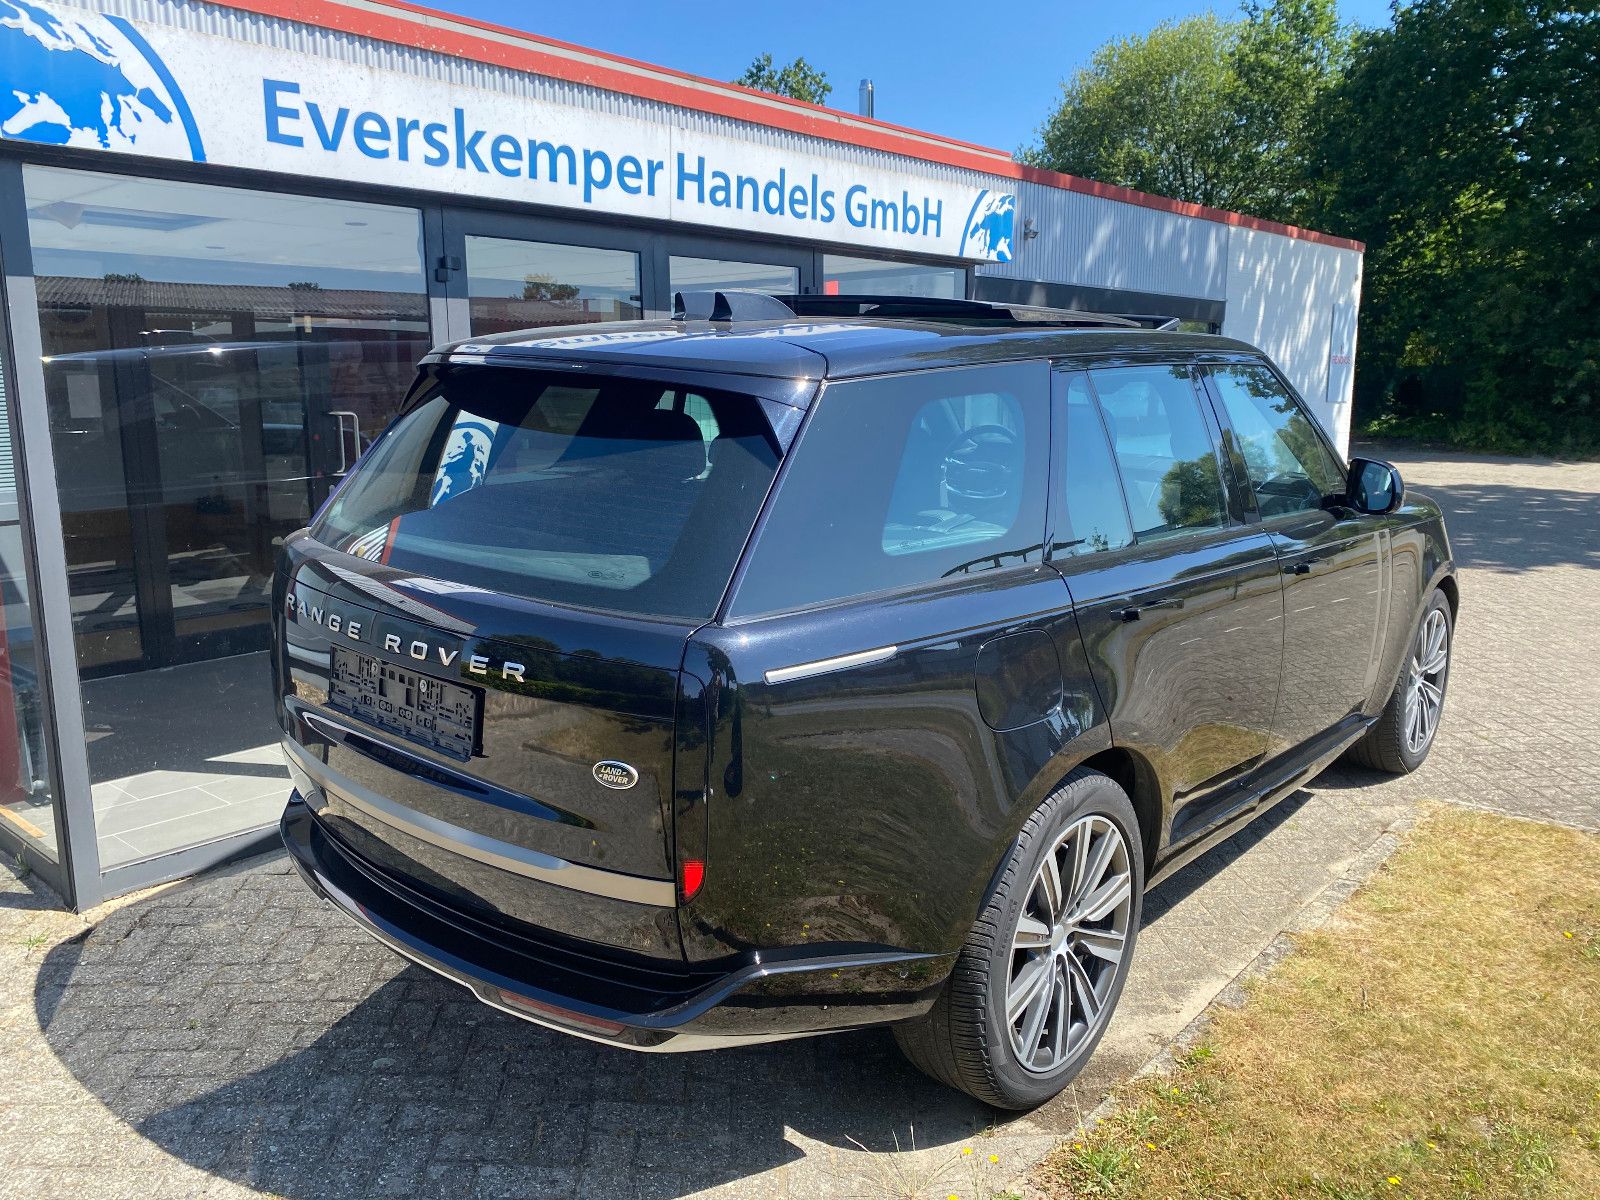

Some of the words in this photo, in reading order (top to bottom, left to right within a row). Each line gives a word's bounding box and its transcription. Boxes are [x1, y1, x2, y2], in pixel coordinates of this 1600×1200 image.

[263, 78, 664, 203] Everskemper
[677, 152, 835, 223] Handels
[845, 184, 943, 238] GmbH
[286, 592, 362, 641] RANGE
[384, 633, 526, 683] ROVER
[601, 766, 622, 776] LAND
[602, 774, 629, 784] ROVER
